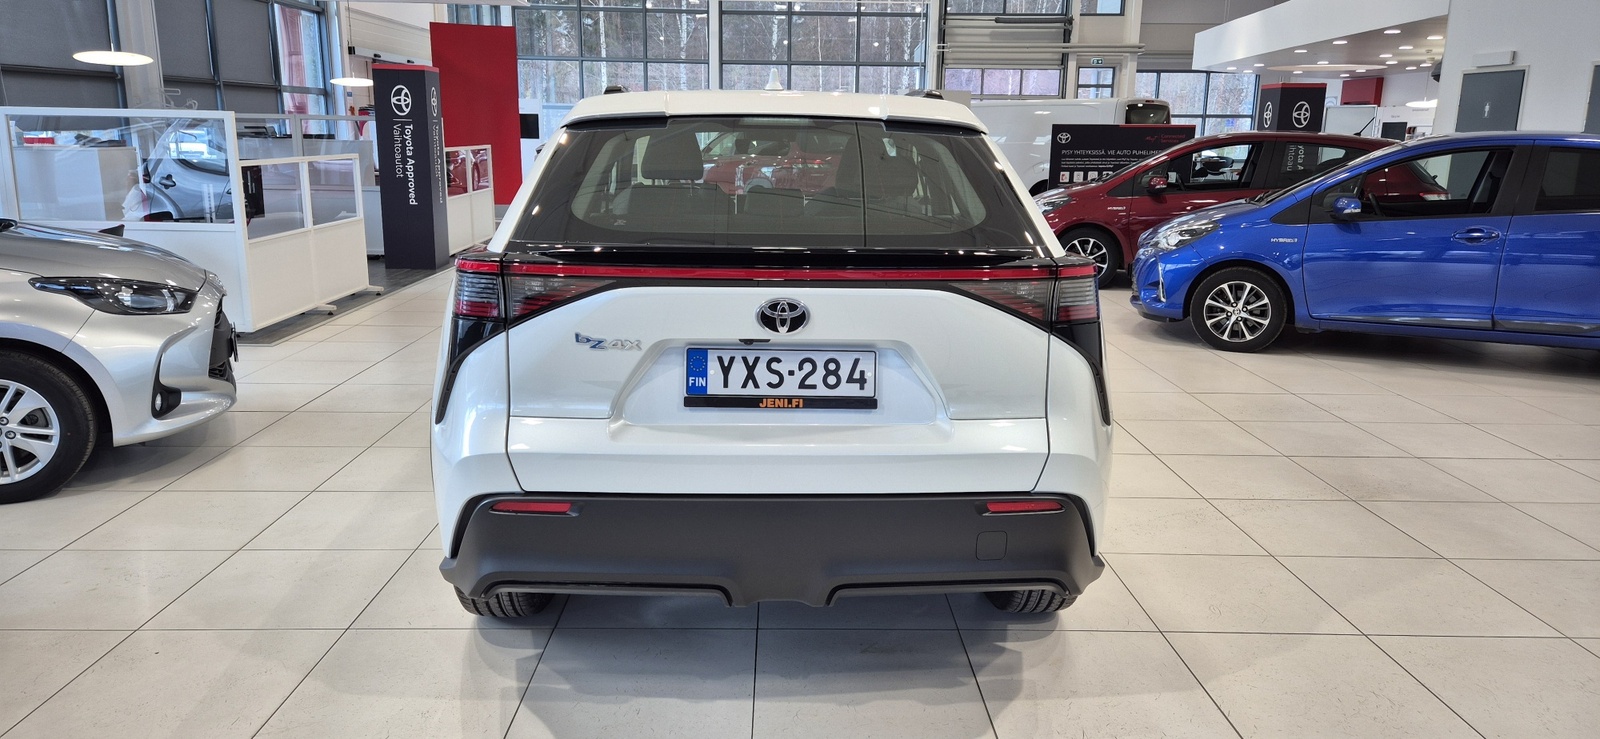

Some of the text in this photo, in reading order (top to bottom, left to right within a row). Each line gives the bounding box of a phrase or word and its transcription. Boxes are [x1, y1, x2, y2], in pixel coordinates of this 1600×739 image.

[393, 123, 404, 178] Vaihtoautot
[403, 124, 418, 205] Toyota Approved
[688, 376, 707, 387] FIN
[716, 355, 868, 391] YXS-284
[759, 398, 804, 408] JENI.FI
